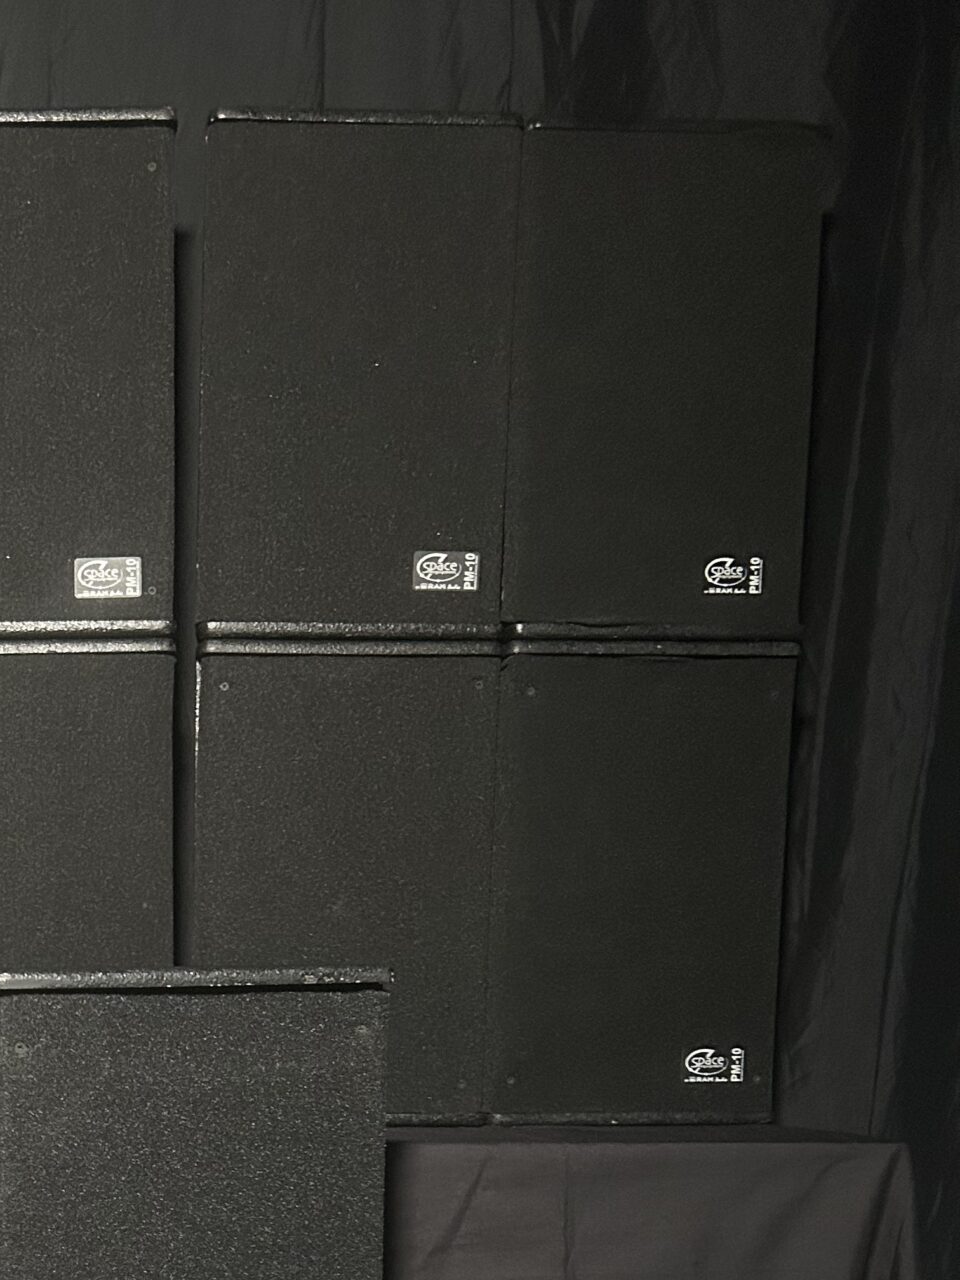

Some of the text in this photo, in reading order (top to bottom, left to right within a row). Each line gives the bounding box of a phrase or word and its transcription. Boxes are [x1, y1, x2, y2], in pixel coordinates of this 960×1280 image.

[464, 553, 476, 590] PM-10
[749, 557, 761, 594] PM-10
[730, 1048, 742, 1082] PM-10
